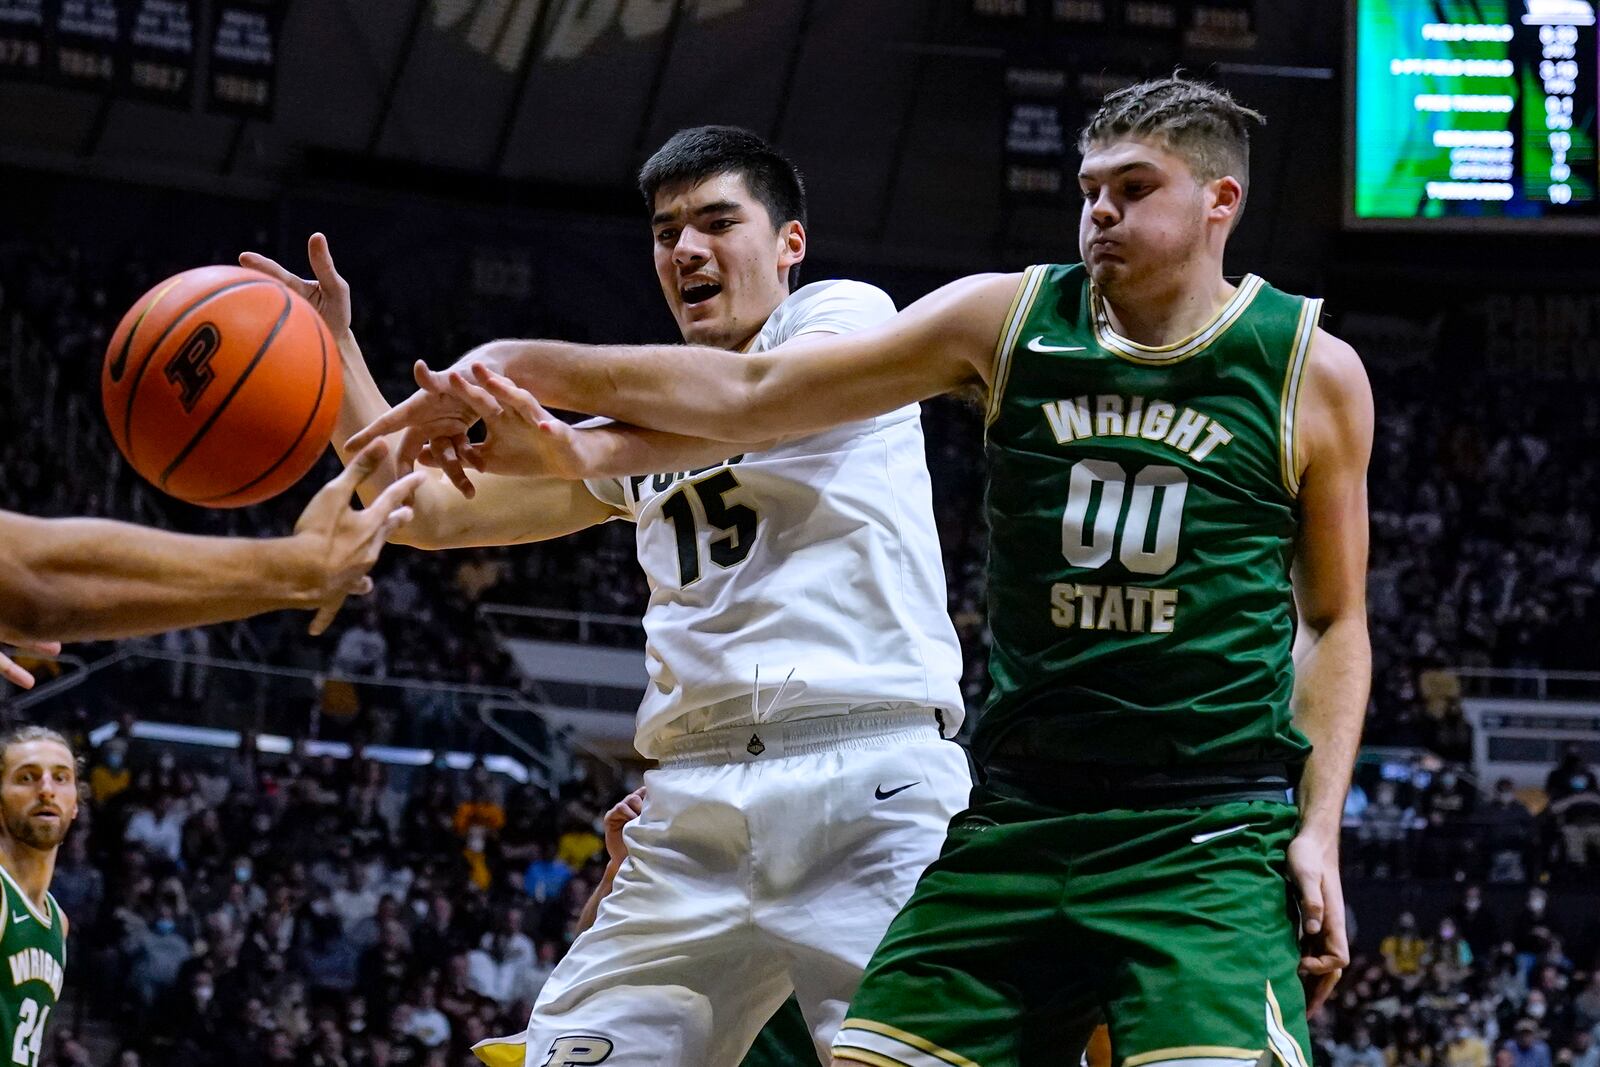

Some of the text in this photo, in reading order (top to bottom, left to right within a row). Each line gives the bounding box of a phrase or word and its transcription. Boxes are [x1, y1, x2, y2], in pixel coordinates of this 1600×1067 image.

[164, 321, 222, 414] P
[1042, 394, 1234, 462] WRIGHT
[661, 467, 759, 589] 15
[1062, 458, 1189, 575] 00
[1051, 582, 1178, 633] STATE
[12, 997, 51, 1067] 24
